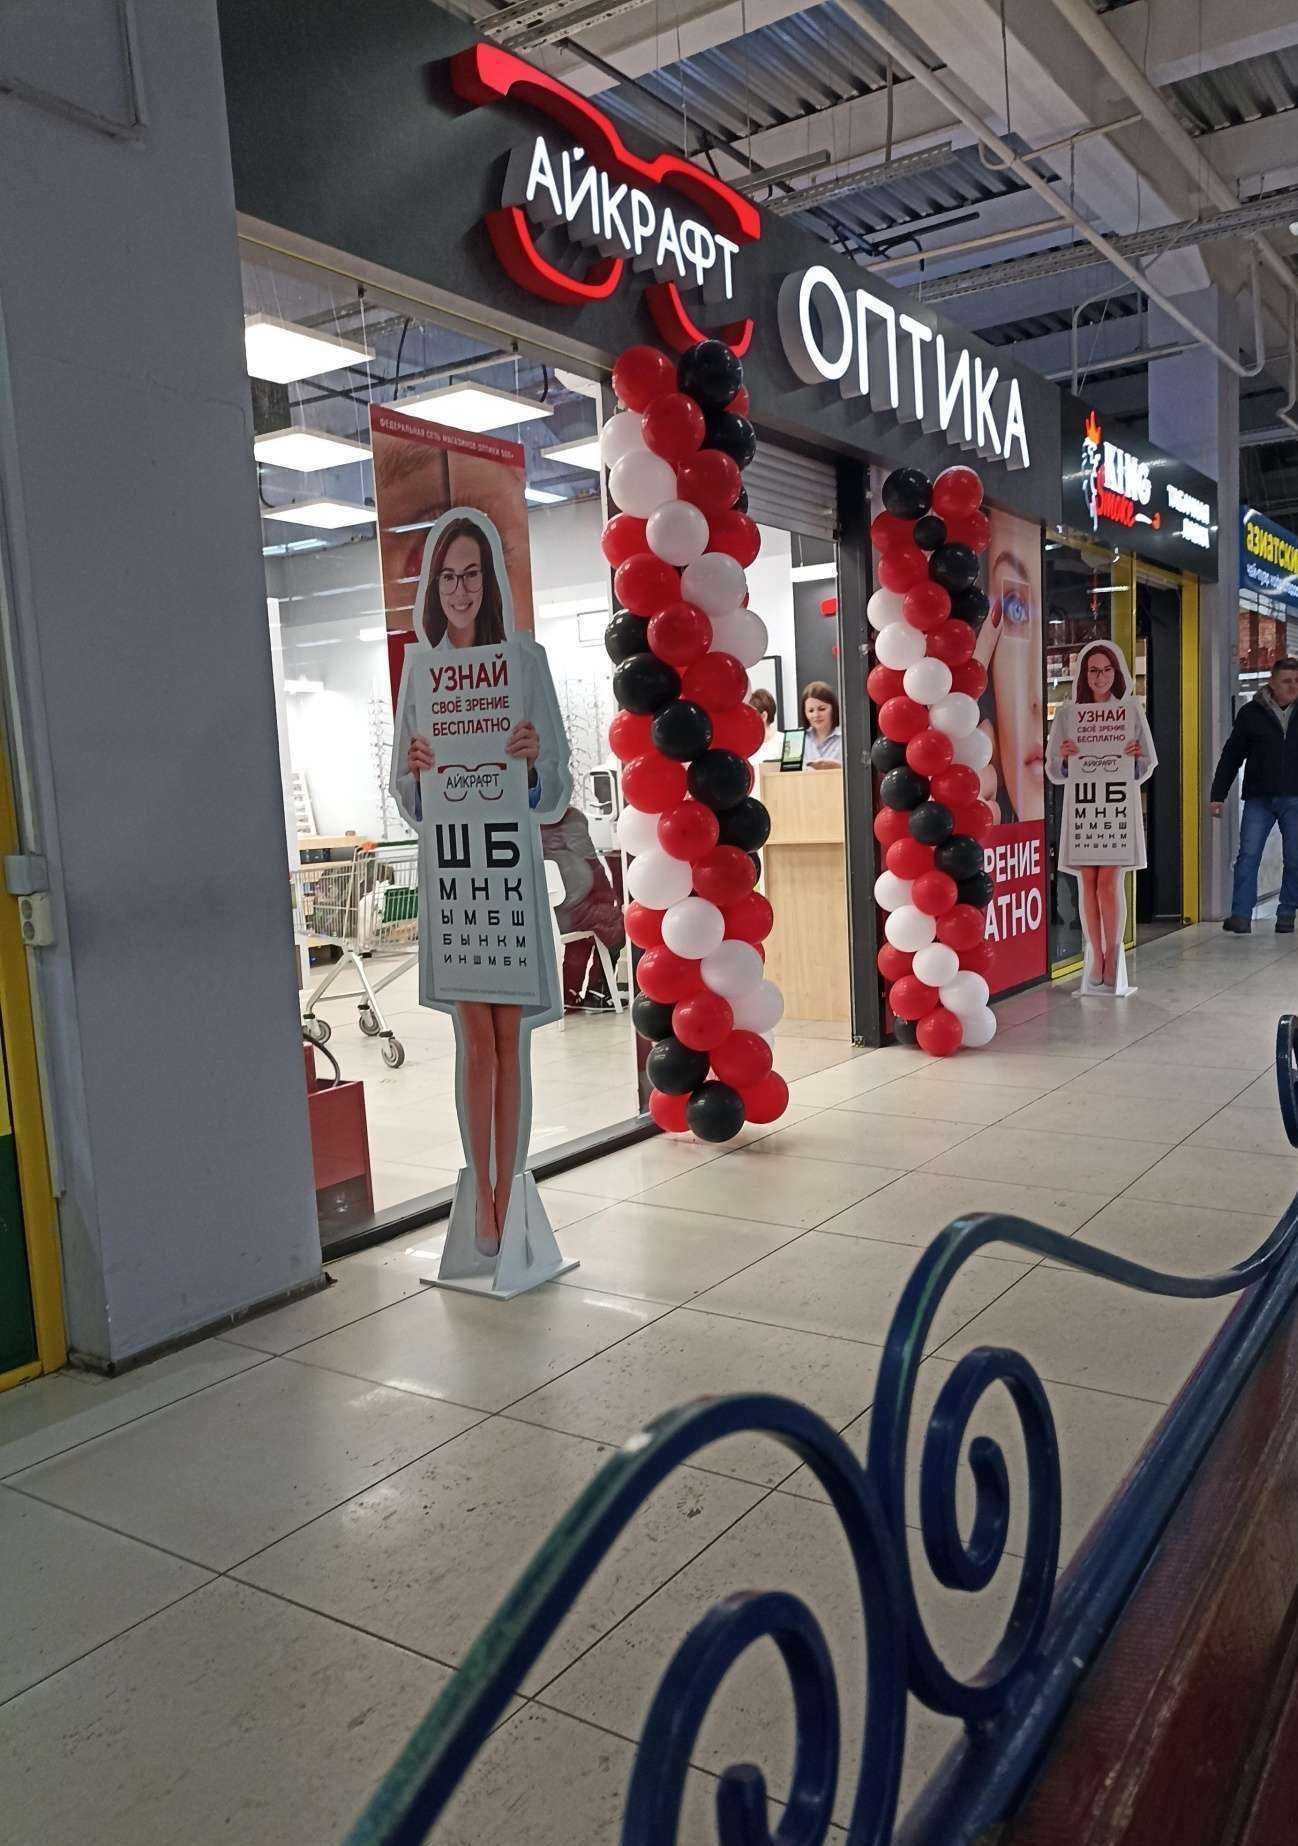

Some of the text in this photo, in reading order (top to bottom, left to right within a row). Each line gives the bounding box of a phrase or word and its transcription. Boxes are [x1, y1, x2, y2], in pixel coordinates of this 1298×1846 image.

[526, 136, 740, 299] АЙКРАФТ
[799, 265, 1030, 468] ОПТИКА
[430, 653, 508, 693] УЗНАЙ
[432, 696, 510, 715] СВОЁ ЗРЕНИЕ
[1077, 706, 1126, 723] УЗНАЙ
[433, 717, 511, 737] БЕСПЛАТНО
[1077, 735, 1126, 743] БЕСПЛАТНО
[446, 772, 500, 789] АЙКРАФТ
[983, 839, 1041, 883] РЕНИЕ
[984, 887, 1042, 942] АТНО
